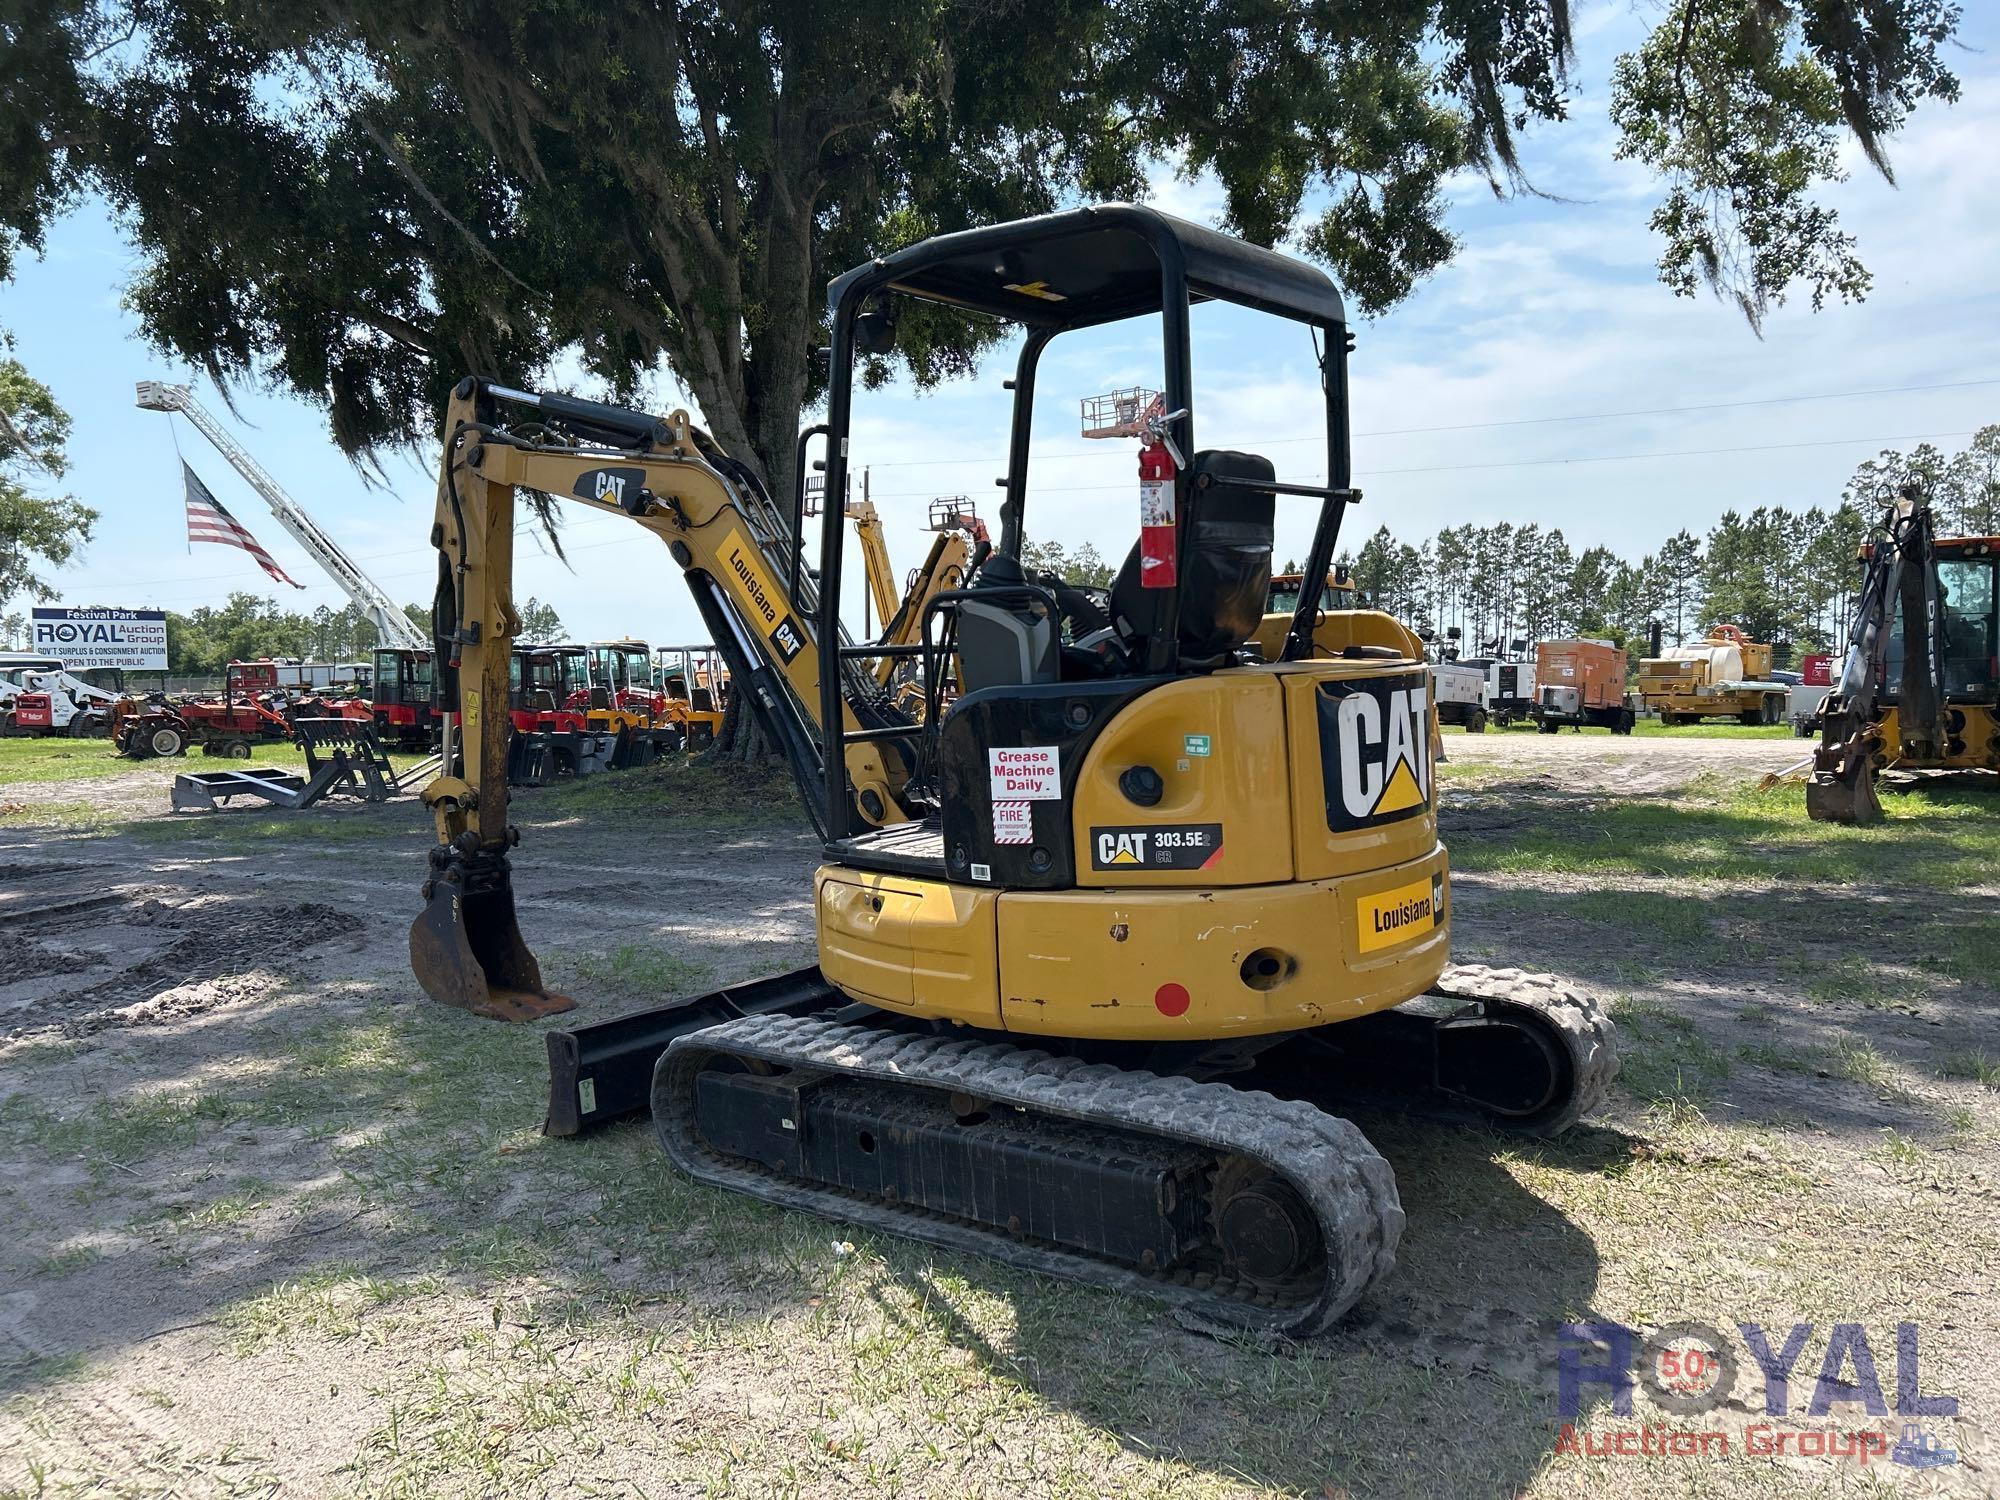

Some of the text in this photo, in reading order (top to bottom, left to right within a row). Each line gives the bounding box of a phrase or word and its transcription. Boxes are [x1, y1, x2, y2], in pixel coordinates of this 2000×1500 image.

[595, 471, 626, 507] CAT
[728, 548, 800, 655] Louisiana CAT
[66, 610, 138, 620] Festival Park
[37, 623, 125, 643] ROYAL
[119, 624, 164, 634] Auction
[127, 634, 165, 645] Group
[1928, 600, 1937, 688] DEERE
[58, 647, 88, 655] SURPLUS
[89, 647, 94, 655] &
[95, 647, 139, 655] CONSIGNMENT
[140, 647, 166, 655] AUCTION
[63, 658, 145, 666] OPEN TO THE PUBLIC
[998, 751, 1049, 763] Grease
[1338, 687, 1428, 817] CAT
[994, 765, 1055, 777] Machine
[1006, 779, 1043, 793] Daily
[999, 810, 1024, 822] FIRE
[1098, 833, 1147, 864] CAT
[1155, 850, 1172, 863] CR
[1374, 898, 1431, 933] Louisiana
